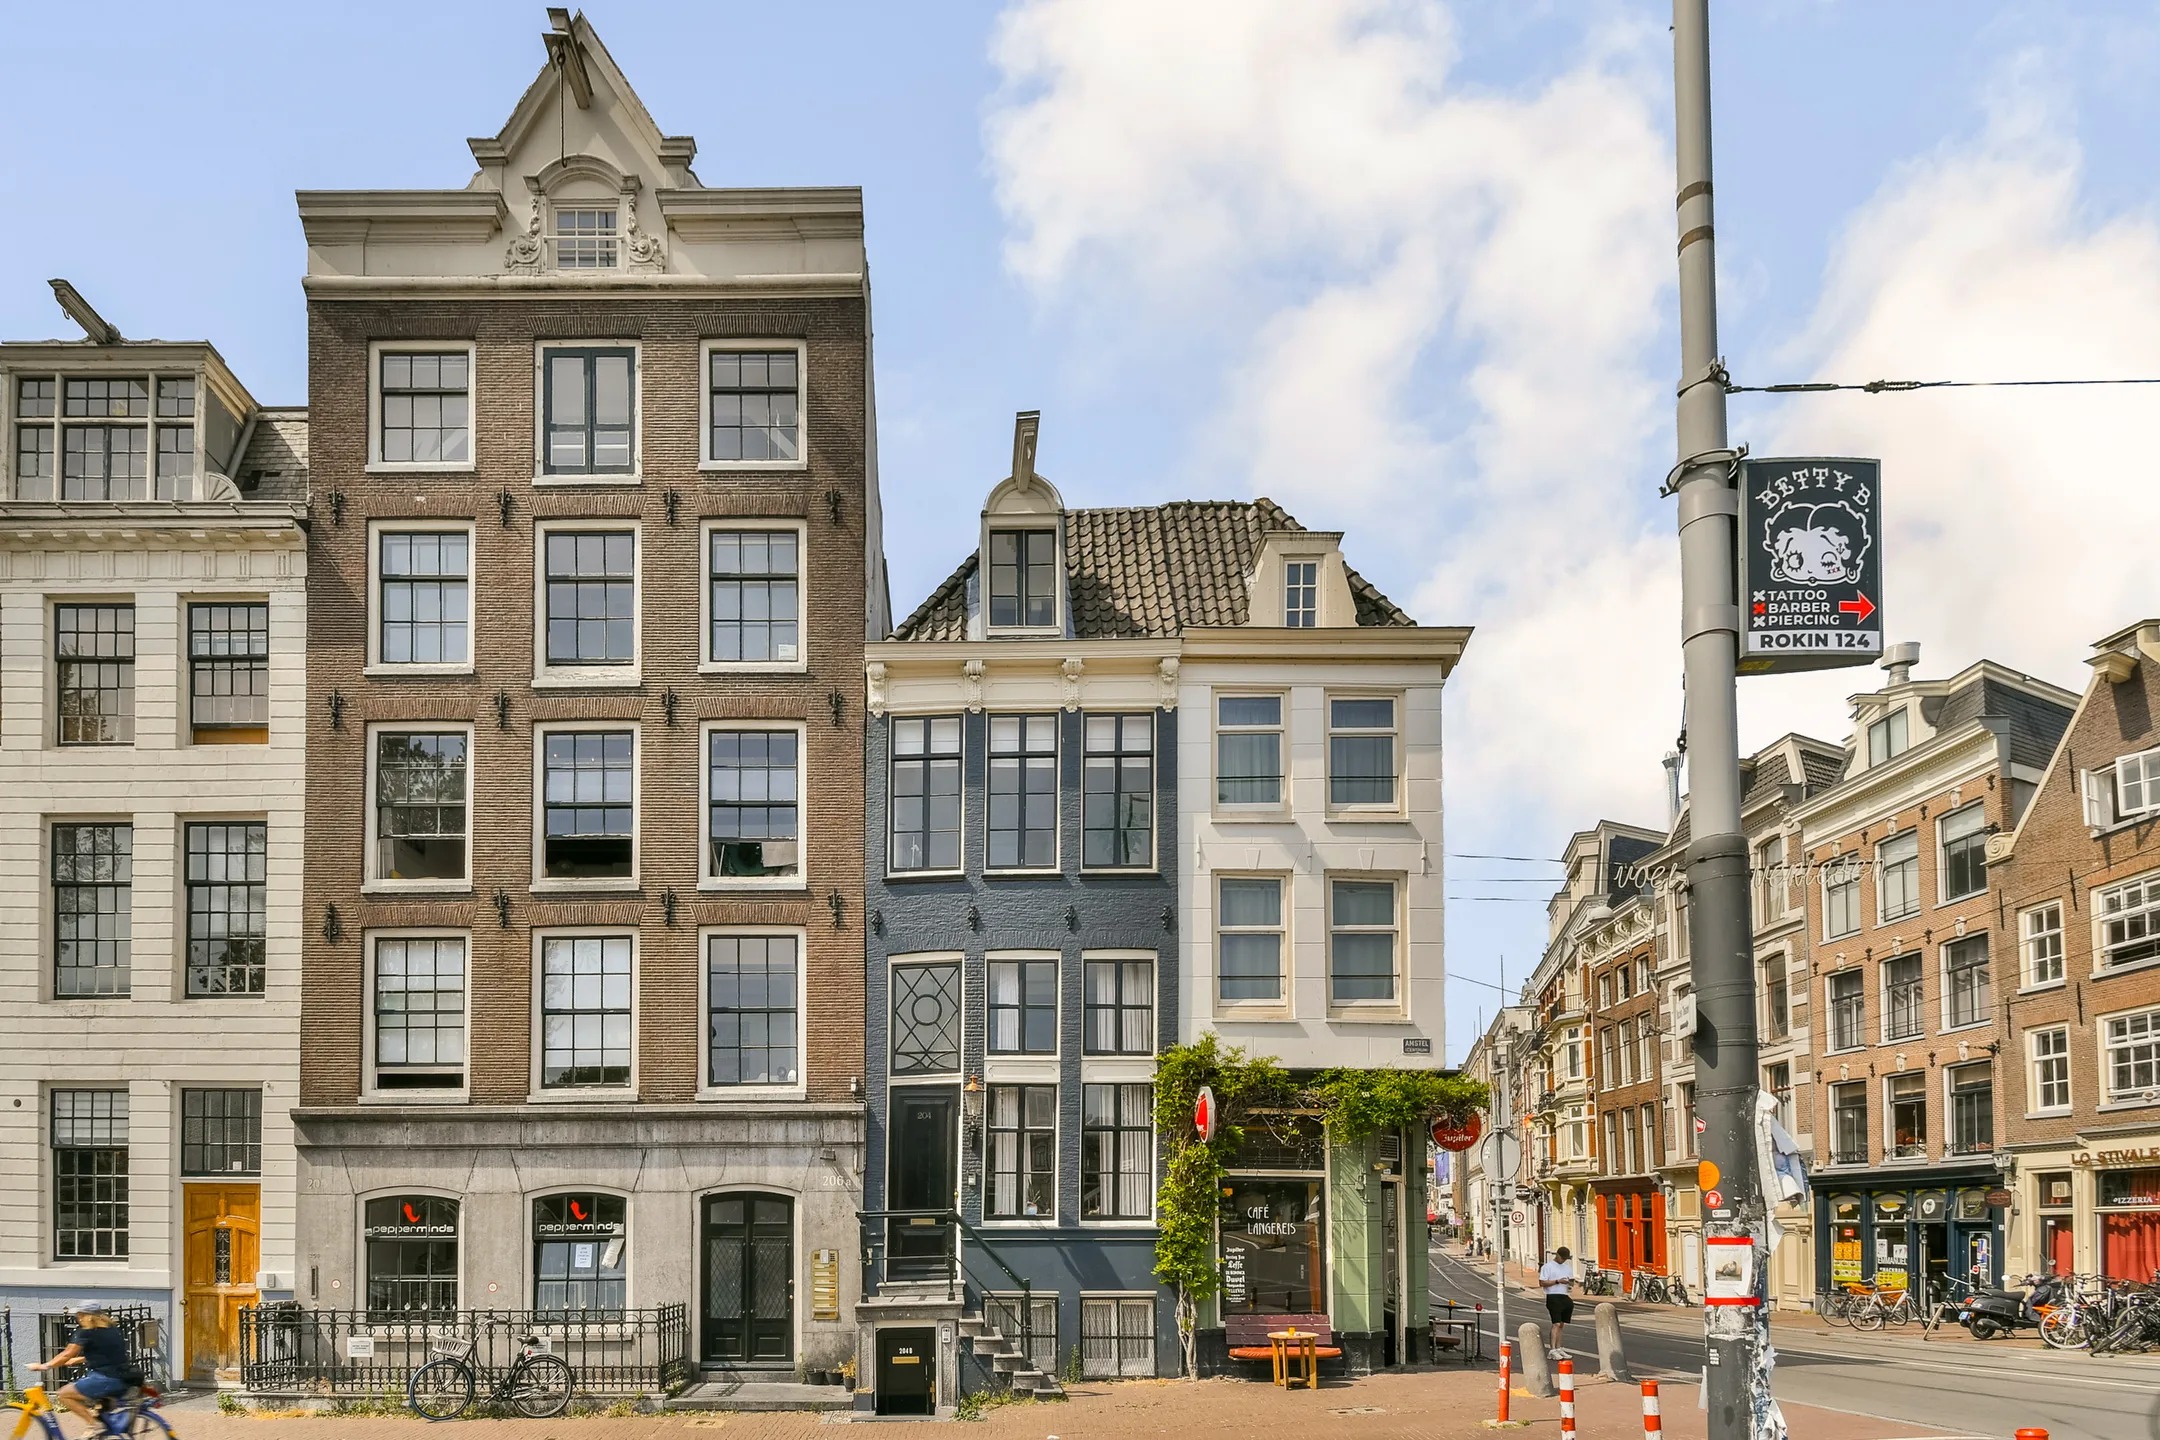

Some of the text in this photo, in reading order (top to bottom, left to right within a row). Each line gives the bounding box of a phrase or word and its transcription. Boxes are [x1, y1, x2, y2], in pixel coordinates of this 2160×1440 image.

[1755, 467, 1853, 510] BETTY
[1767, 590, 1828, 601] TATTOO
[1768, 602, 1831, 614] BARBER
[1768, 614, 1841, 626] PIERCING
[1760, 633, 1871, 648] ROKIN 124
[1443, 1134, 1473, 1143] Jupiler
[2071, 1147, 2160, 1166] LO STIVALE
[1247, 1204, 1270, 1220] CAFÉ
[372, 1224, 454, 1234] pepperminds
[1248, 1222, 1296, 1235] LANGEREIS
